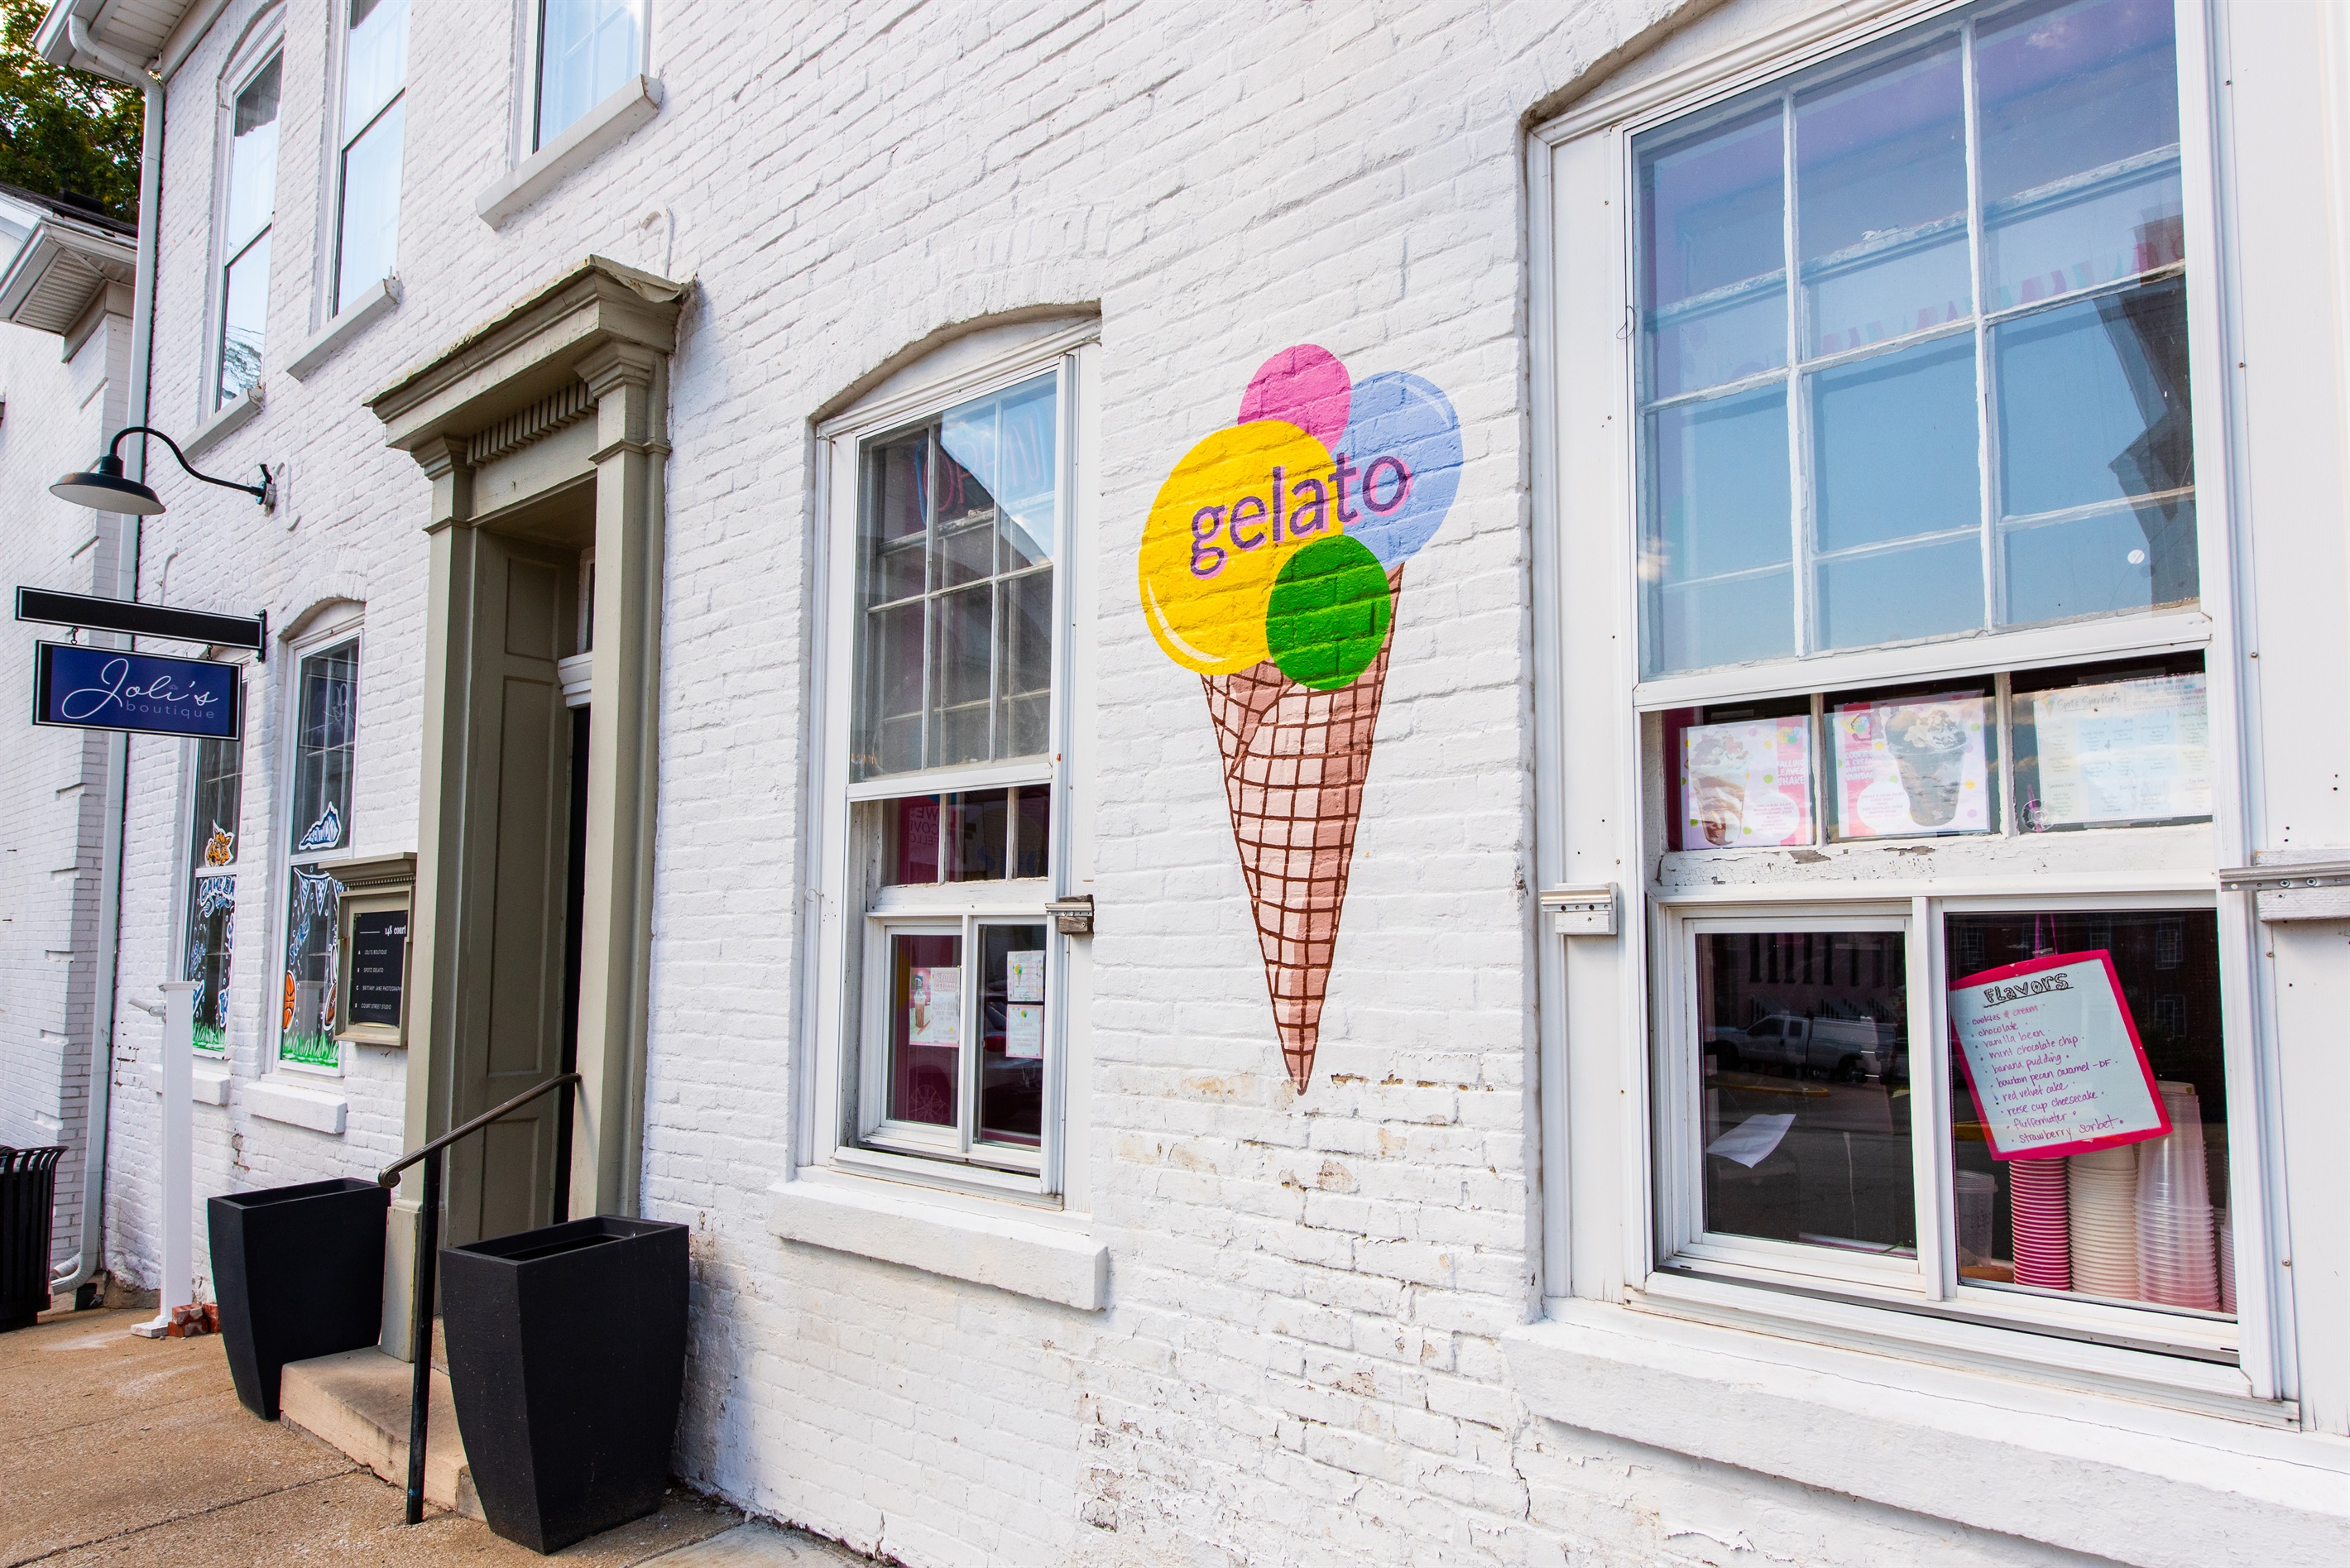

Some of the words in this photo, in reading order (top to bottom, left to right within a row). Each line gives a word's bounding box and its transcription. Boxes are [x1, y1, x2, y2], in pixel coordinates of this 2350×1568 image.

[1190, 453, 1413, 580] gelato
[62, 659, 218, 719] Joli's
[127, 701, 215, 719] boutique
[1776, 760, 1805, 768] FALLING
[1777, 768, 1805, 776] LEAVES
[1777, 775, 1805, 785] SHAKE
[394, 925, 406, 935] court
[937, 972, 954, 982] SPOTZ
[934, 982, 957, 992] GELATO
[1972, 1014, 2001, 1025] cookies
[2012, 1005, 2039, 1016] cream
[1978, 1021, 2019, 1037] chocolate
[1983, 1035, 2017, 1048] vanilla
[2018, 1029, 2045, 1042] bean
[1989, 1048, 2012, 1059] mint
[2017, 1039, 2055, 1056] chocolate
[2058, 1035, 2079, 1048] chip
[1992, 1062, 2024, 1074] banana
[2026, 1053, 2061, 1072] pudding
[1996, 1076, 2027, 1088] bourbon
[2030, 1071, 2055, 1086] pecan
[2057, 1062, 2089, 1077] caramel
[2002, 1091, 2018, 1101] red
[2020, 1085, 2043, 1098] velvet
[2045, 1082, 2069, 1094] cake
[2007, 1104, 2028, 1116] reese
[2031, 1102, 2047, 1113] cup
[2051, 1091, 2098, 1107] cheesecake
[2019, 1128, 2073, 1144] strawberry
[2079, 1114, 2119, 1134] sorbet
